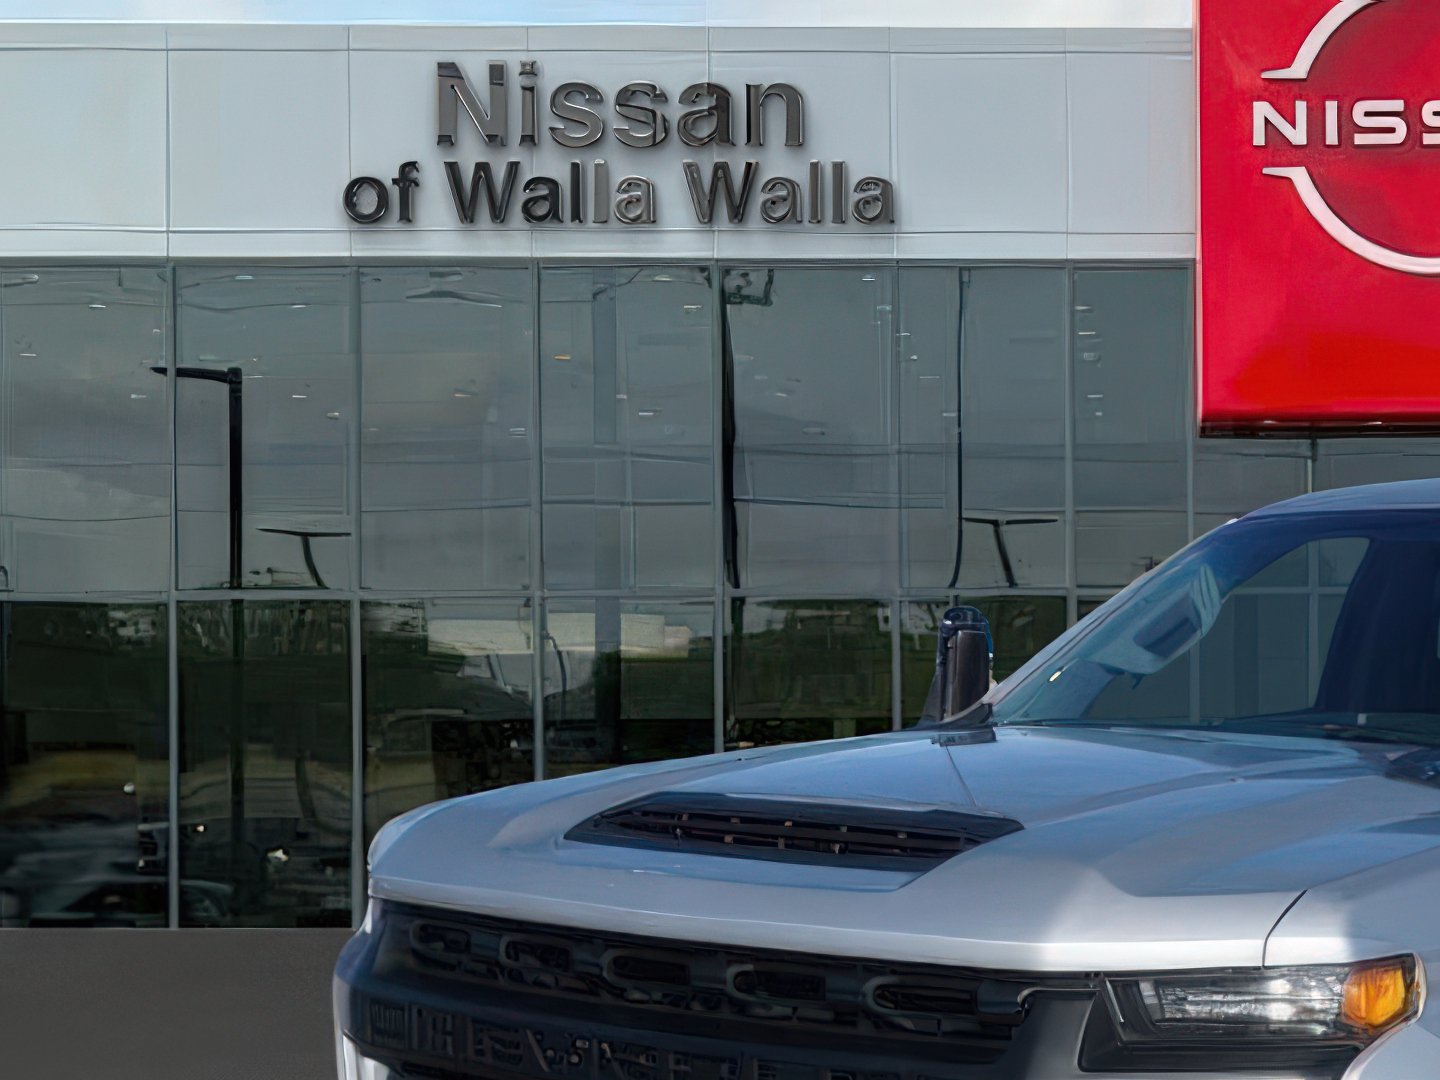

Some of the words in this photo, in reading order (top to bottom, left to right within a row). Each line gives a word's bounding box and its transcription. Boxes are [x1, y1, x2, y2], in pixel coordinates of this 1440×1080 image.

[435, 59, 808, 148] Nissan
[342, 160, 420, 224] of
[443, 159, 658, 225] Walla
[683, 158, 896, 225] Walla
